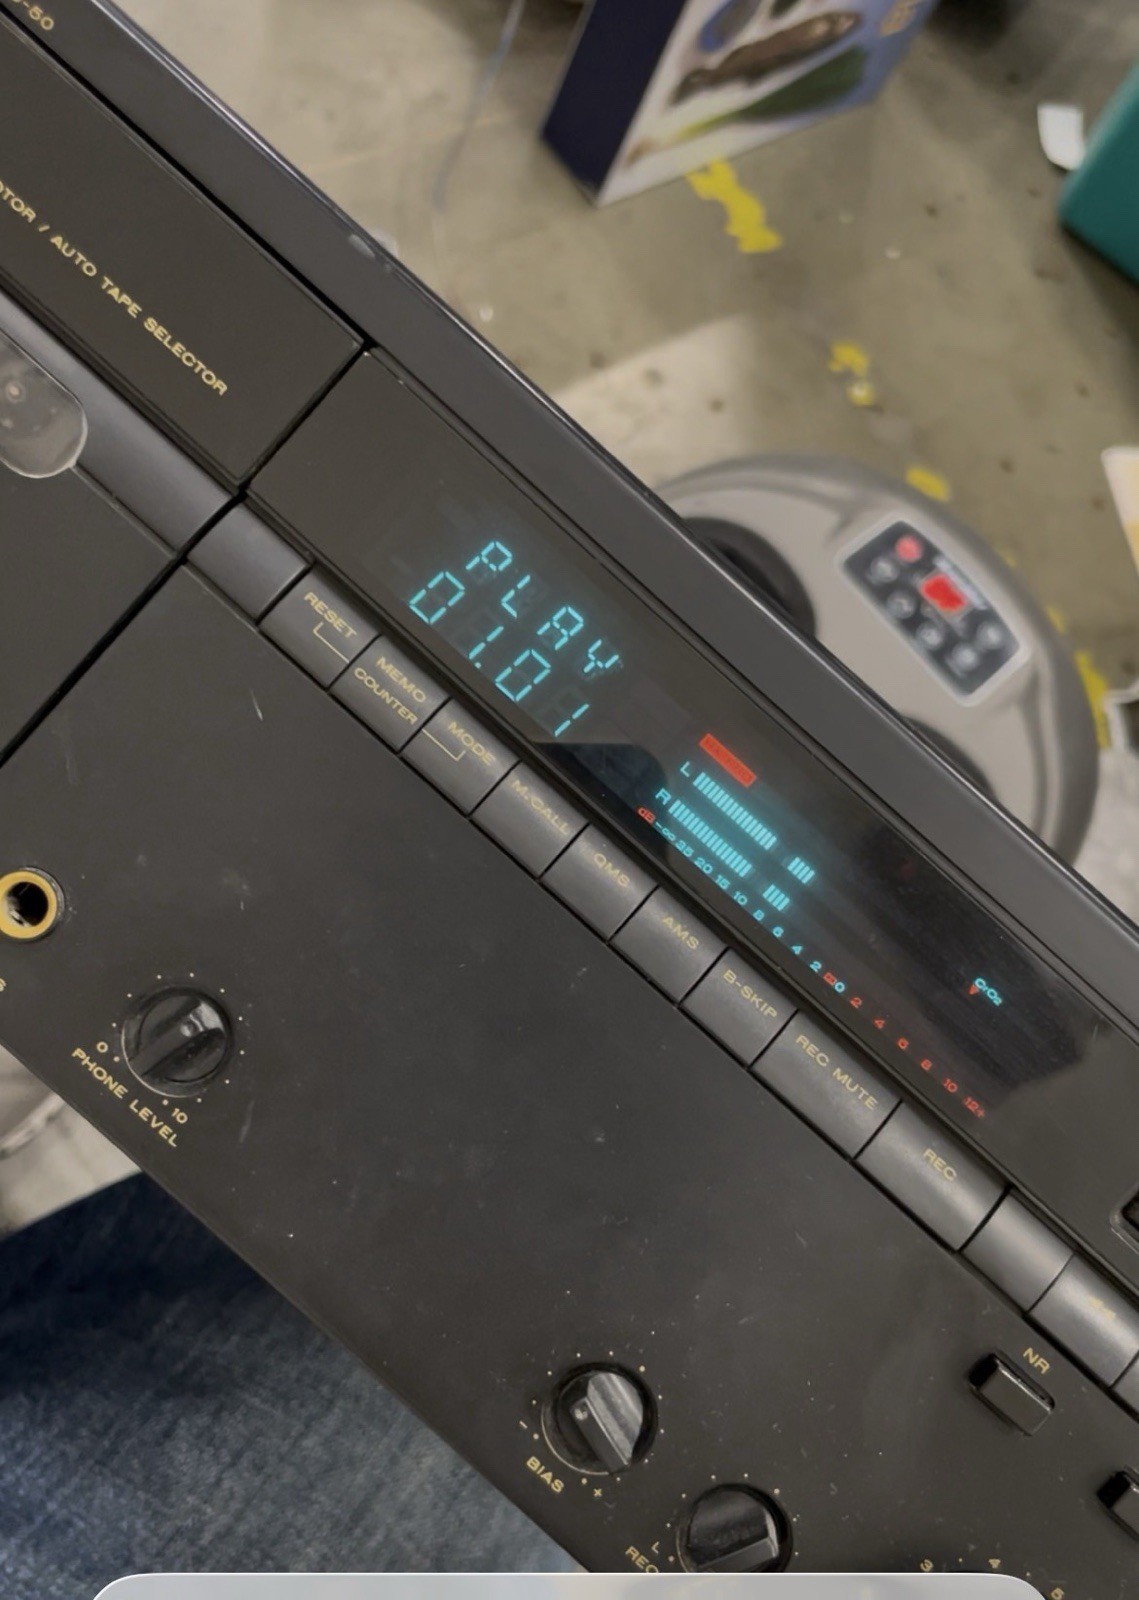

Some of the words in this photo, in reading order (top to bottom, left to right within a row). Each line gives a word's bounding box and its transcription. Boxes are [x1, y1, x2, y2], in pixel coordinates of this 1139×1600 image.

[50, 236, 97, 277] AUTO
[102, 276, 142, 318] TAPE
[144, 317, 228, 396] SELECTOR
[304, 592, 357, 638] RESET
[465, 541, 619, 673] PLAY
[354, 667, 418, 725] COUNTER
[376, 656, 426, 703] MEMO
[449, 722, 496, 766] MODE
[680, 761, 690, 777] L
[655, 788, 671, 805] R
[594, 853, 630, 887] QMS
[638, 807, 655, 824] dB
[694, 857, 713, 874] 20
[716, 875, 730, 890] 15
[734, 891, 748, 906] 10
[773, 926, 784, 938] 6
[791, 945, 803, 955] 4
[810, 961, 822, 972] 2
[850, 997, 862, 1009] 2
[873, 1018, 885, 1029] 4
[943, 1078, 958, 1093] 10
[662, 916, 699, 950] AMS
[723, 969, 778, 1018] B-SKIP
[796, 1035, 830, 1067] REC
[833, 1067, 878, 1111] MUTE
[72, 1048, 128, 1099] PHONE
[129, 1099, 177, 1147] LEVEL
[172, 1108, 188, 1124] 10
[924, 1149, 957, 1181] REC
[1023, 1347, 1050, 1374] NR
[526, 1456, 564, 1493] BIAS
